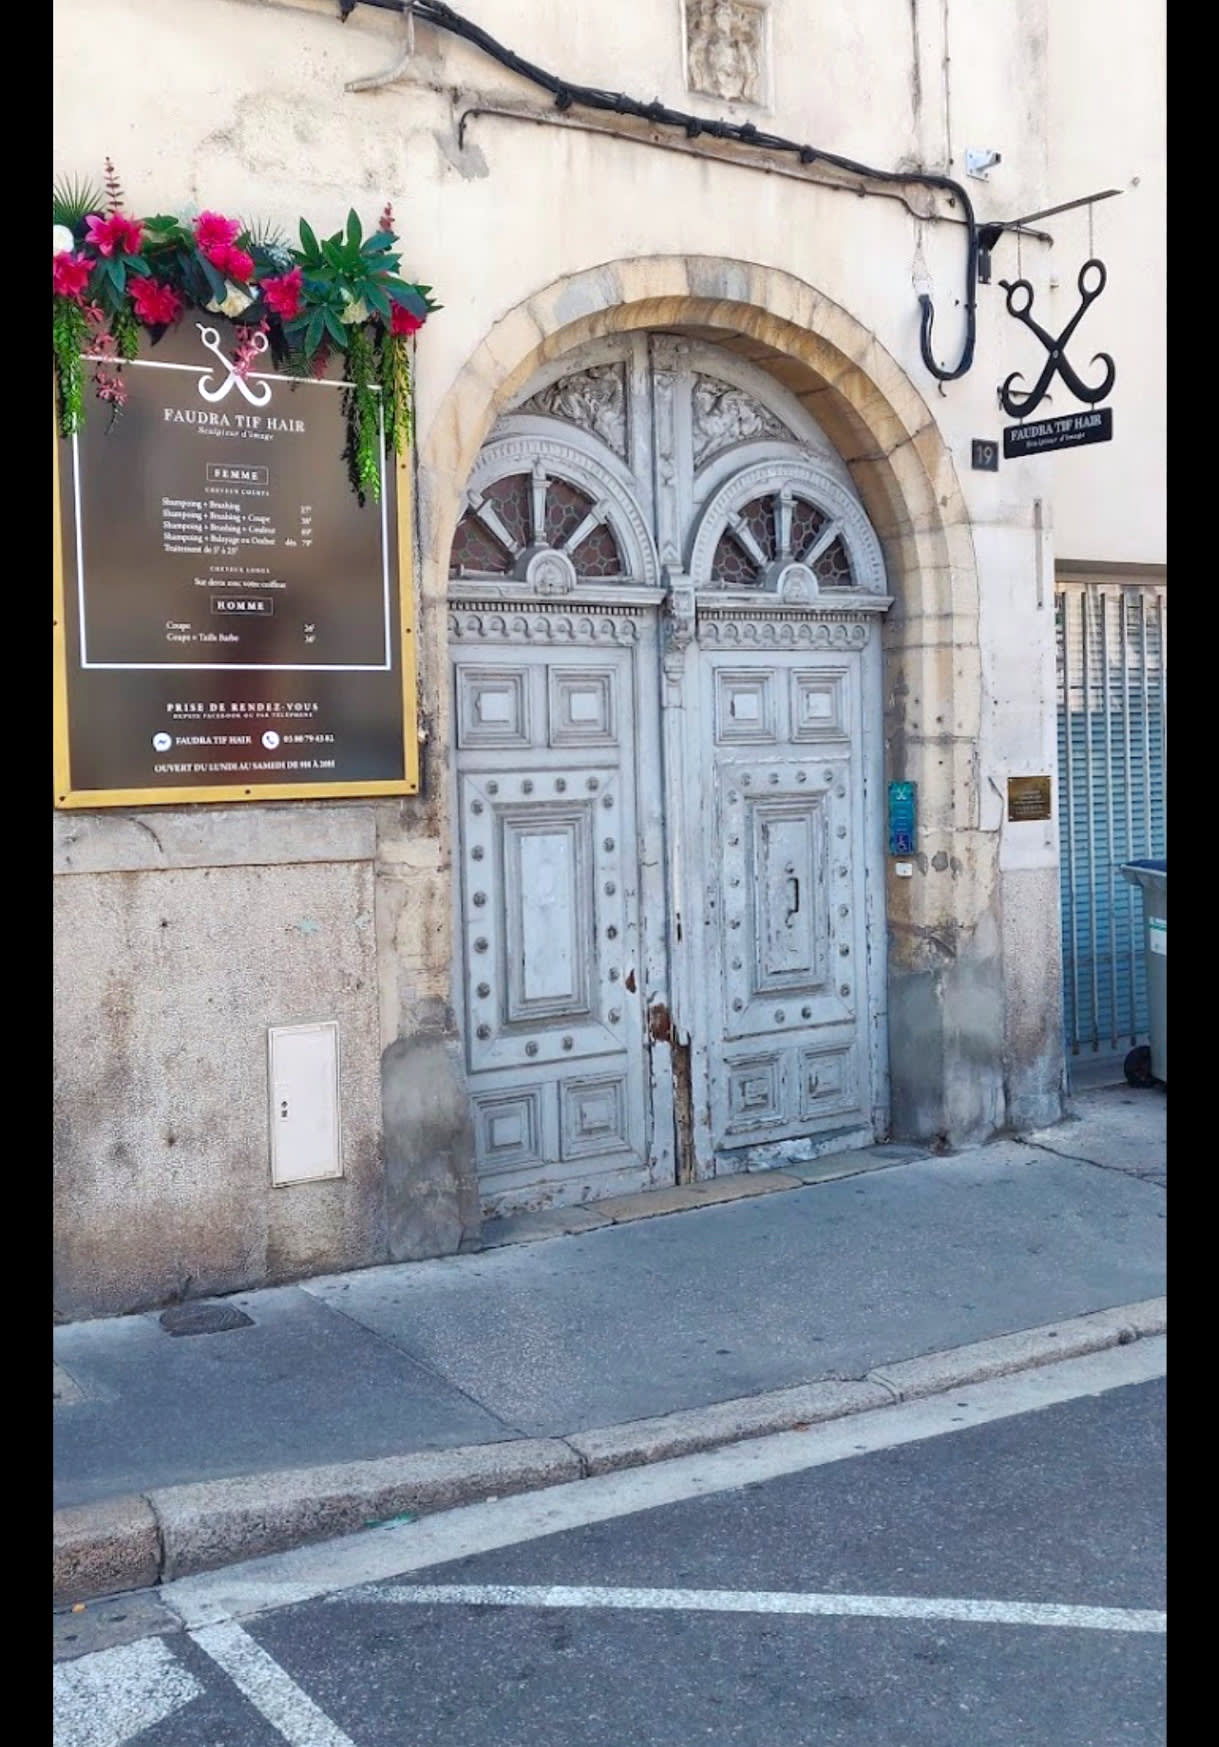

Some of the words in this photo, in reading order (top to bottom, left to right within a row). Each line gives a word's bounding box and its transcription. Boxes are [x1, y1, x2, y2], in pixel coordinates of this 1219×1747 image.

[163, 408, 230, 427] FAUDRA
[235, 415, 262, 429] TIF
[267, 418, 305, 432] HAIR
[1011, 423, 1053, 441] FAUDRA
[1054, 419, 1073, 432] TIF
[1075, 414, 1102, 430] HAIR
[977, 446, 993, 465] 19
[214, 469, 258, 480] FEMME
[217, 601, 264, 610] HOMME
[166, 621, 191, 631] Coupe
[166, 703, 204, 712] PRISE
[210, 703, 226, 712] DE
[231, 702, 319, 712] RENDEZ-VOUS
[176, 736, 212, 745] FAUDRA
[213, 736, 228, 744] TIF
[229, 736, 252, 744] HAIR
[154, 763, 192, 773] OUVERT
[193, 763, 207, 772] DU
[208, 762, 237, 771] LUNDI
[253, 761, 286, 770] SAMEDI
